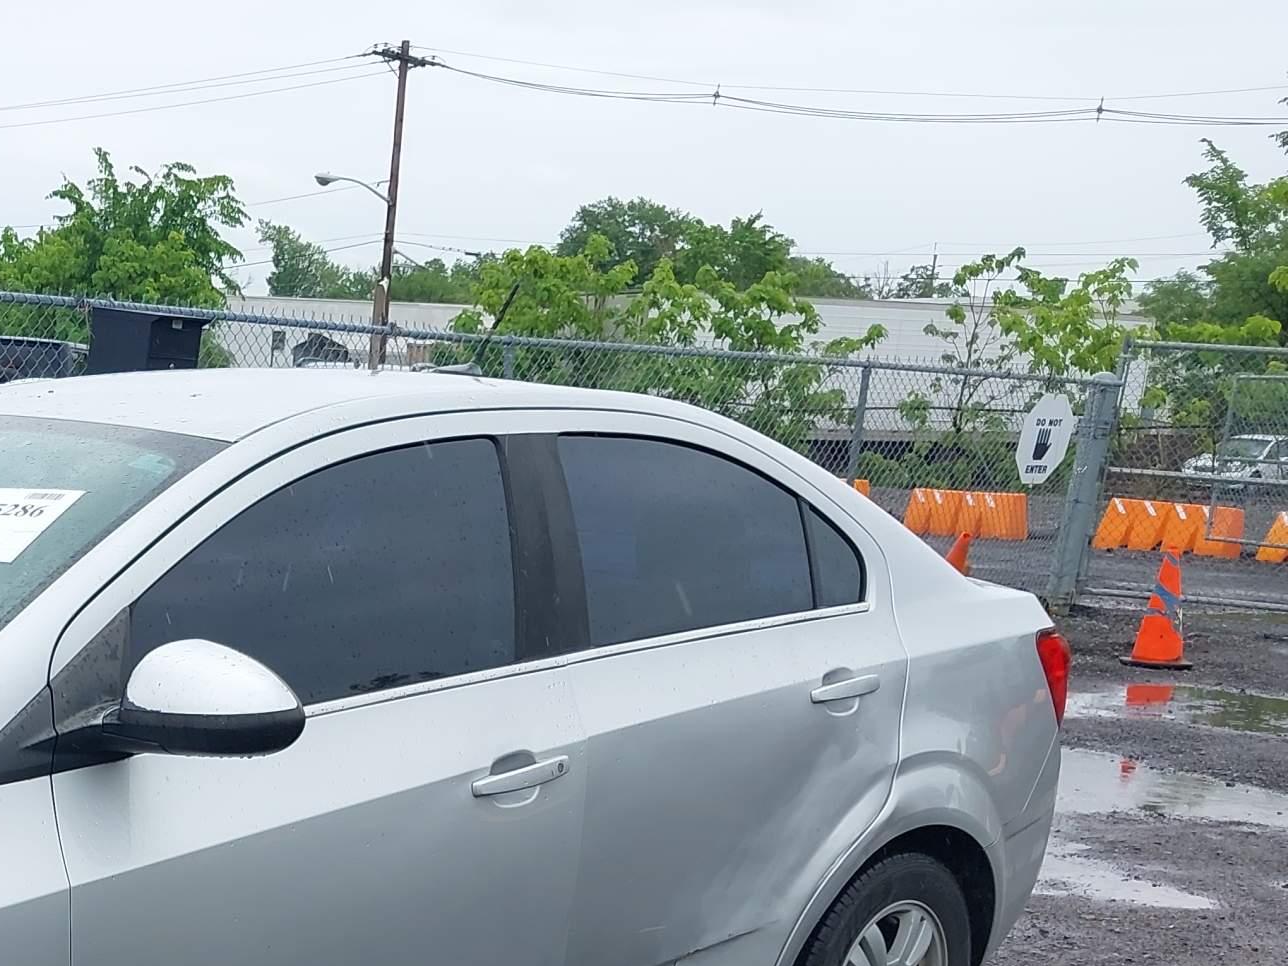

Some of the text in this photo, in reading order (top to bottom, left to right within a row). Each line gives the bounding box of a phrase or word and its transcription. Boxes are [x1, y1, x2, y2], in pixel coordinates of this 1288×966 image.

[1036, 418, 1064, 427] DO NOT
[1025, 464, 1048, 474] ENTER
